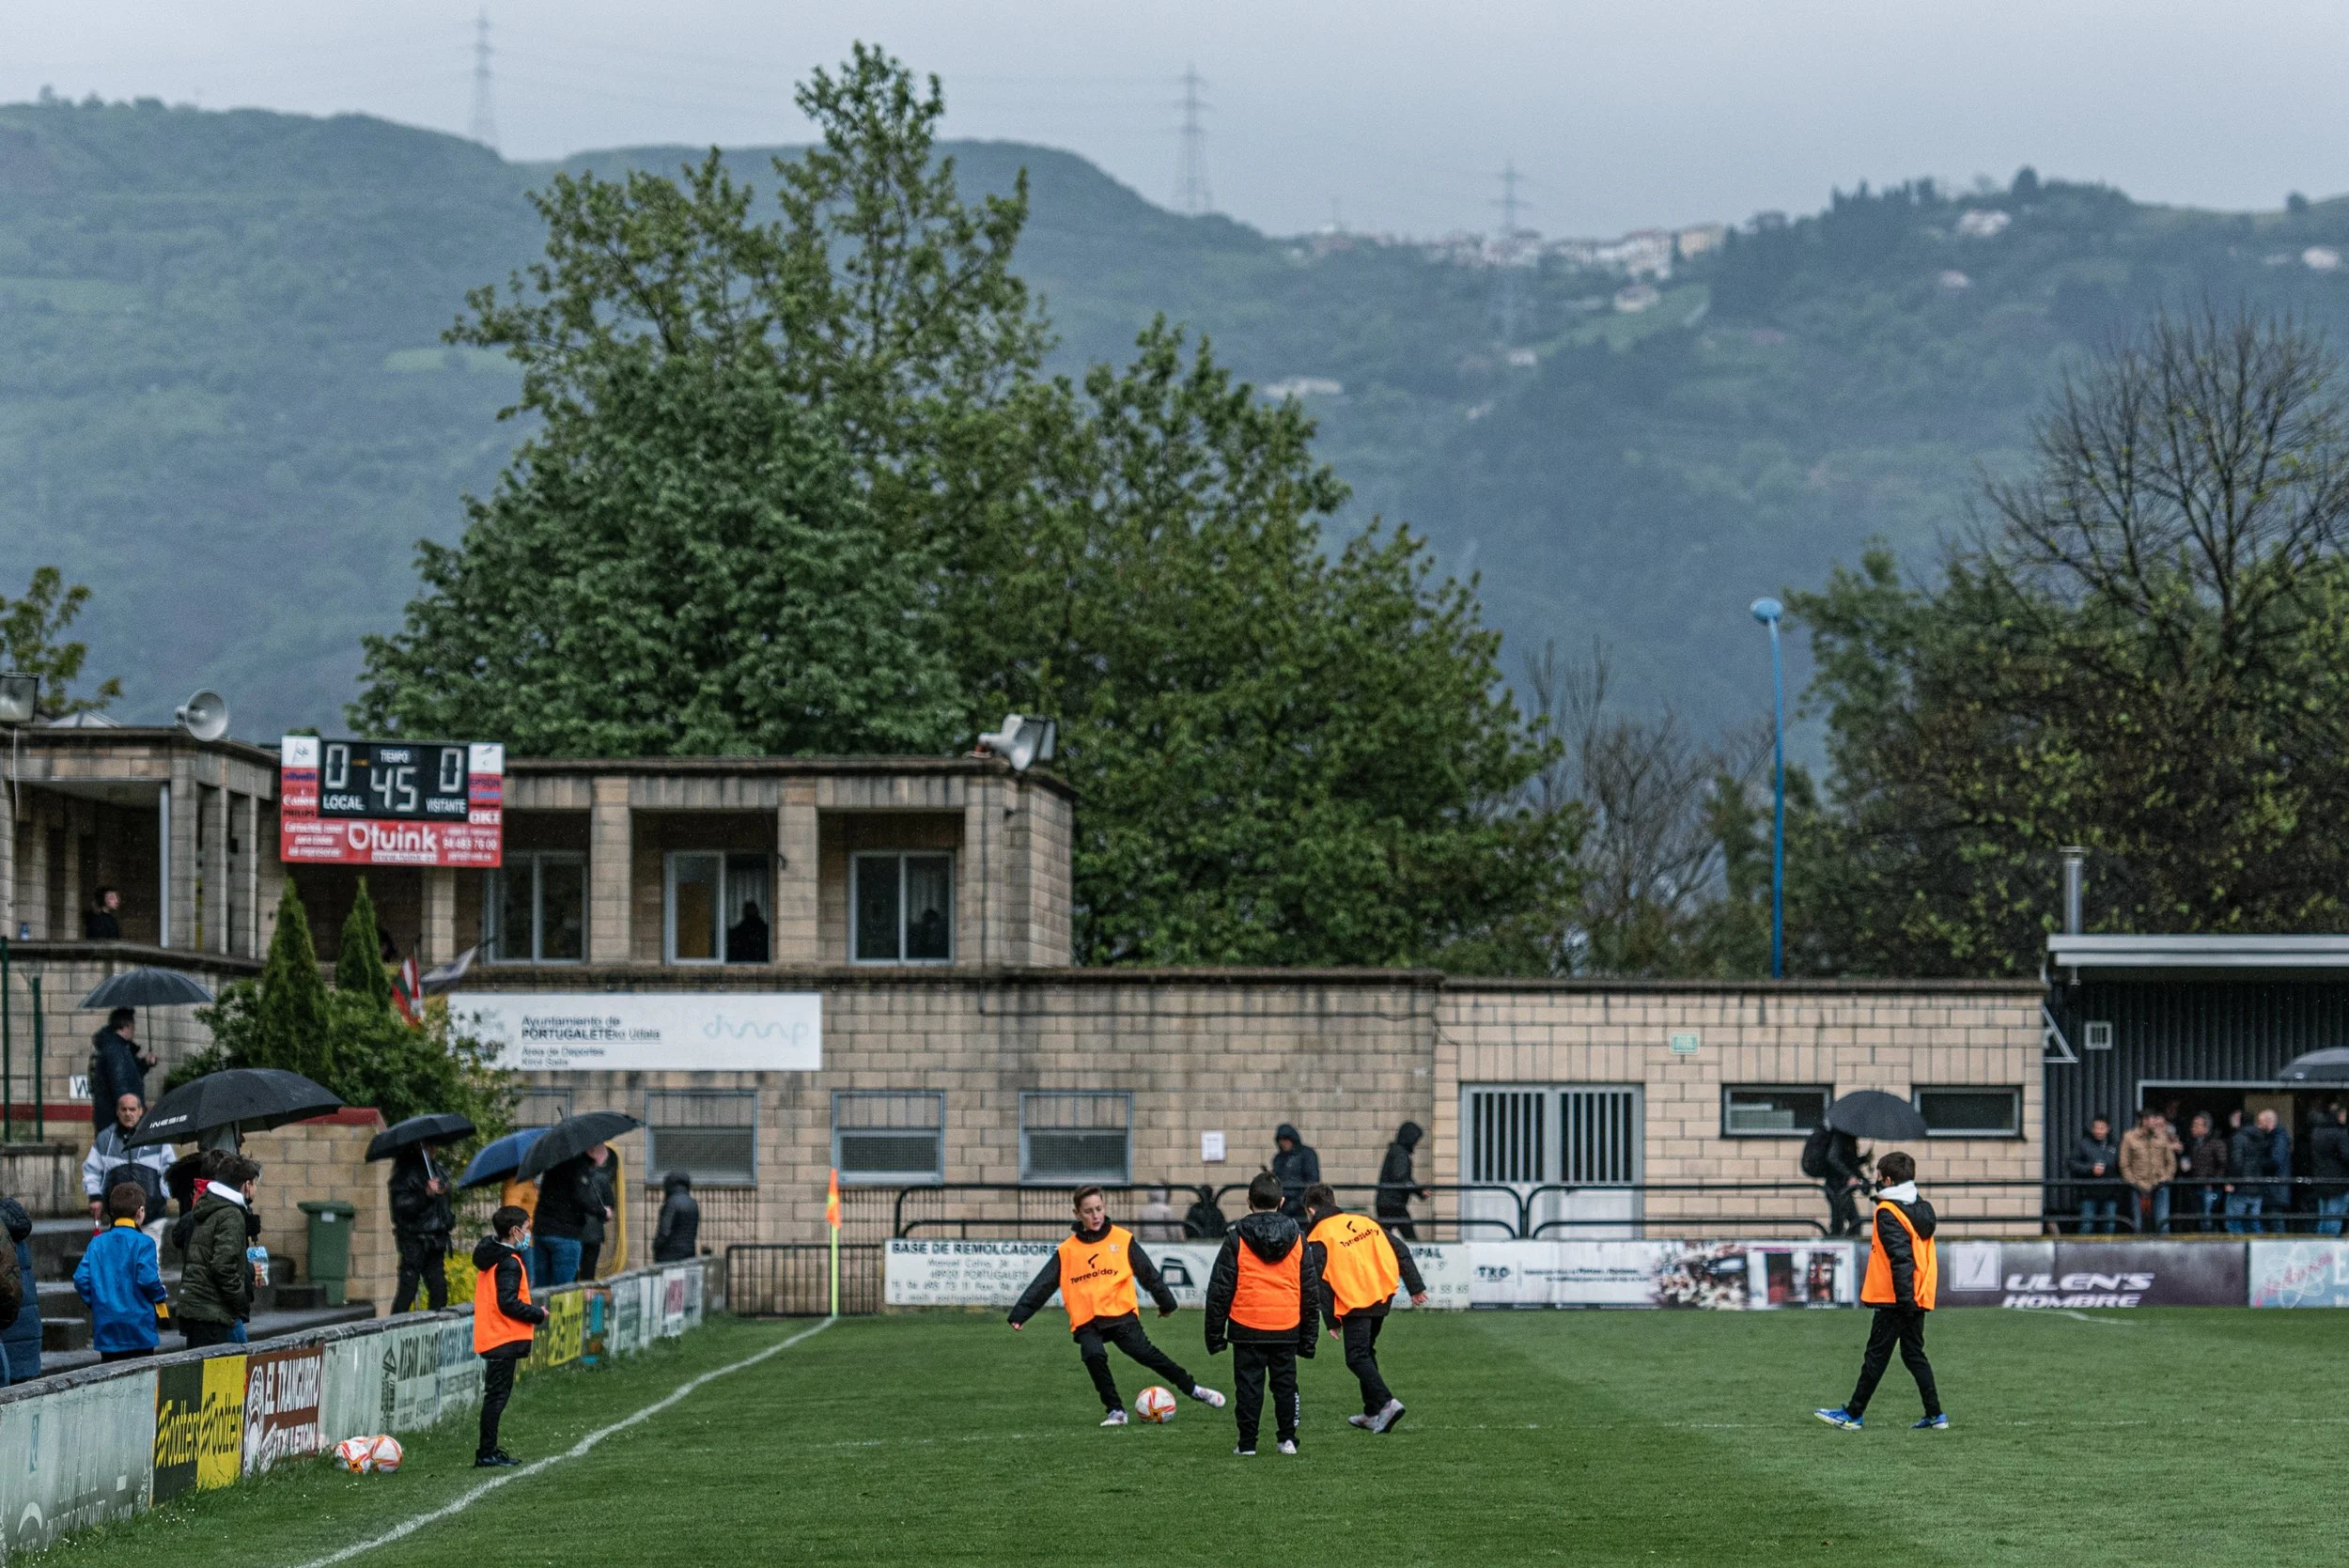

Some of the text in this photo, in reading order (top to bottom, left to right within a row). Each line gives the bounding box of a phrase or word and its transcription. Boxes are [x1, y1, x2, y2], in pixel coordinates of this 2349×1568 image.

[380, 749, 412, 763] TIEMPO
[325, 743, 350, 789] 0
[439, 747, 464, 793] 0
[370, 766, 418, 812] 45
[322, 794, 366, 811] LOCAL
[426, 798, 467, 814] VISITANTE
[521, 1015, 621, 1028] Ayuntamiento de
[149, 1114, 188, 1128] INESIS
[893, 1242, 1058, 1256] BASE DE REMOLCADORE
[1070, 1268, 1118, 1284] Terrealday
[2004, 1272, 2155, 1291] ULEN'S
[2001, 1294, 2142, 1309] HOMBRE
[265, 1362, 274, 1415] EL
[277, 1355, 321, 1413] TXANGURRO
